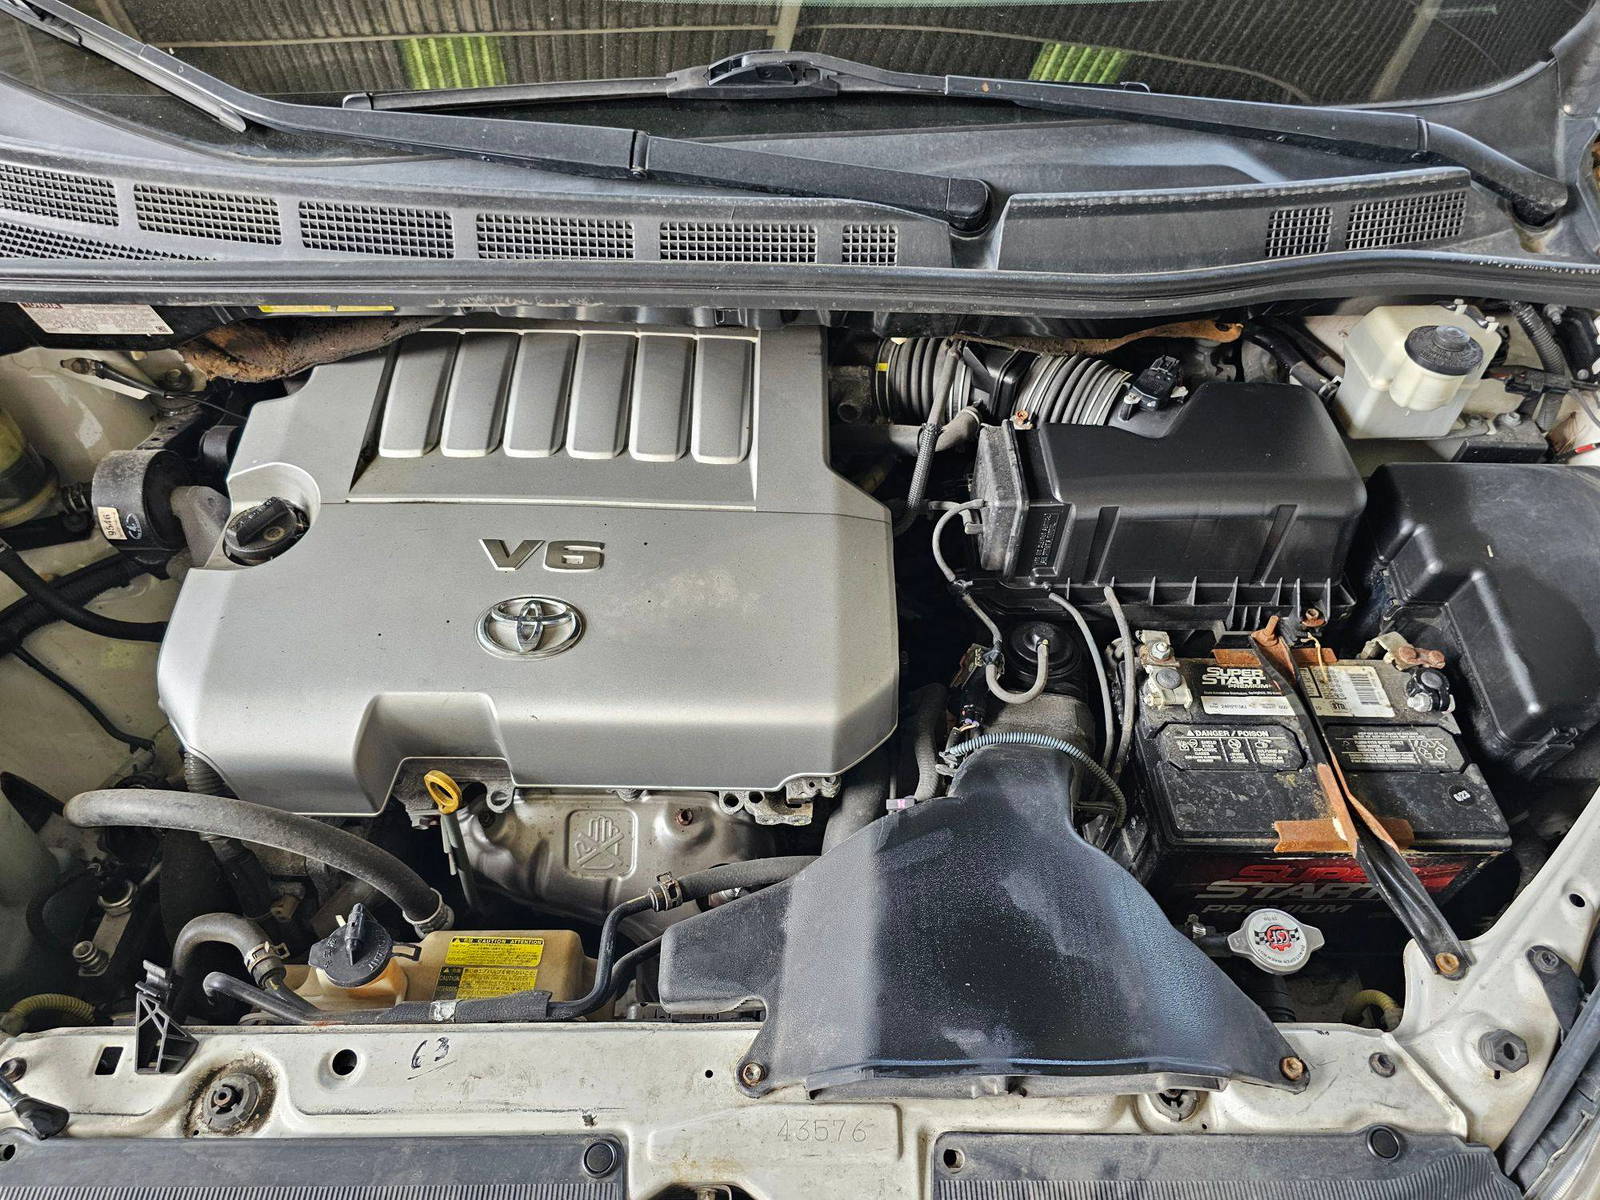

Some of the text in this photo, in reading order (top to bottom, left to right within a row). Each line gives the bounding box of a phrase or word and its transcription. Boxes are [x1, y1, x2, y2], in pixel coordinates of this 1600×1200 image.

[479, 539, 605, 573] V6
[1201, 674, 1266, 686] START
[1206, 666, 1264, 678] SUPER
[777, 1119, 867, 1142] 43576
